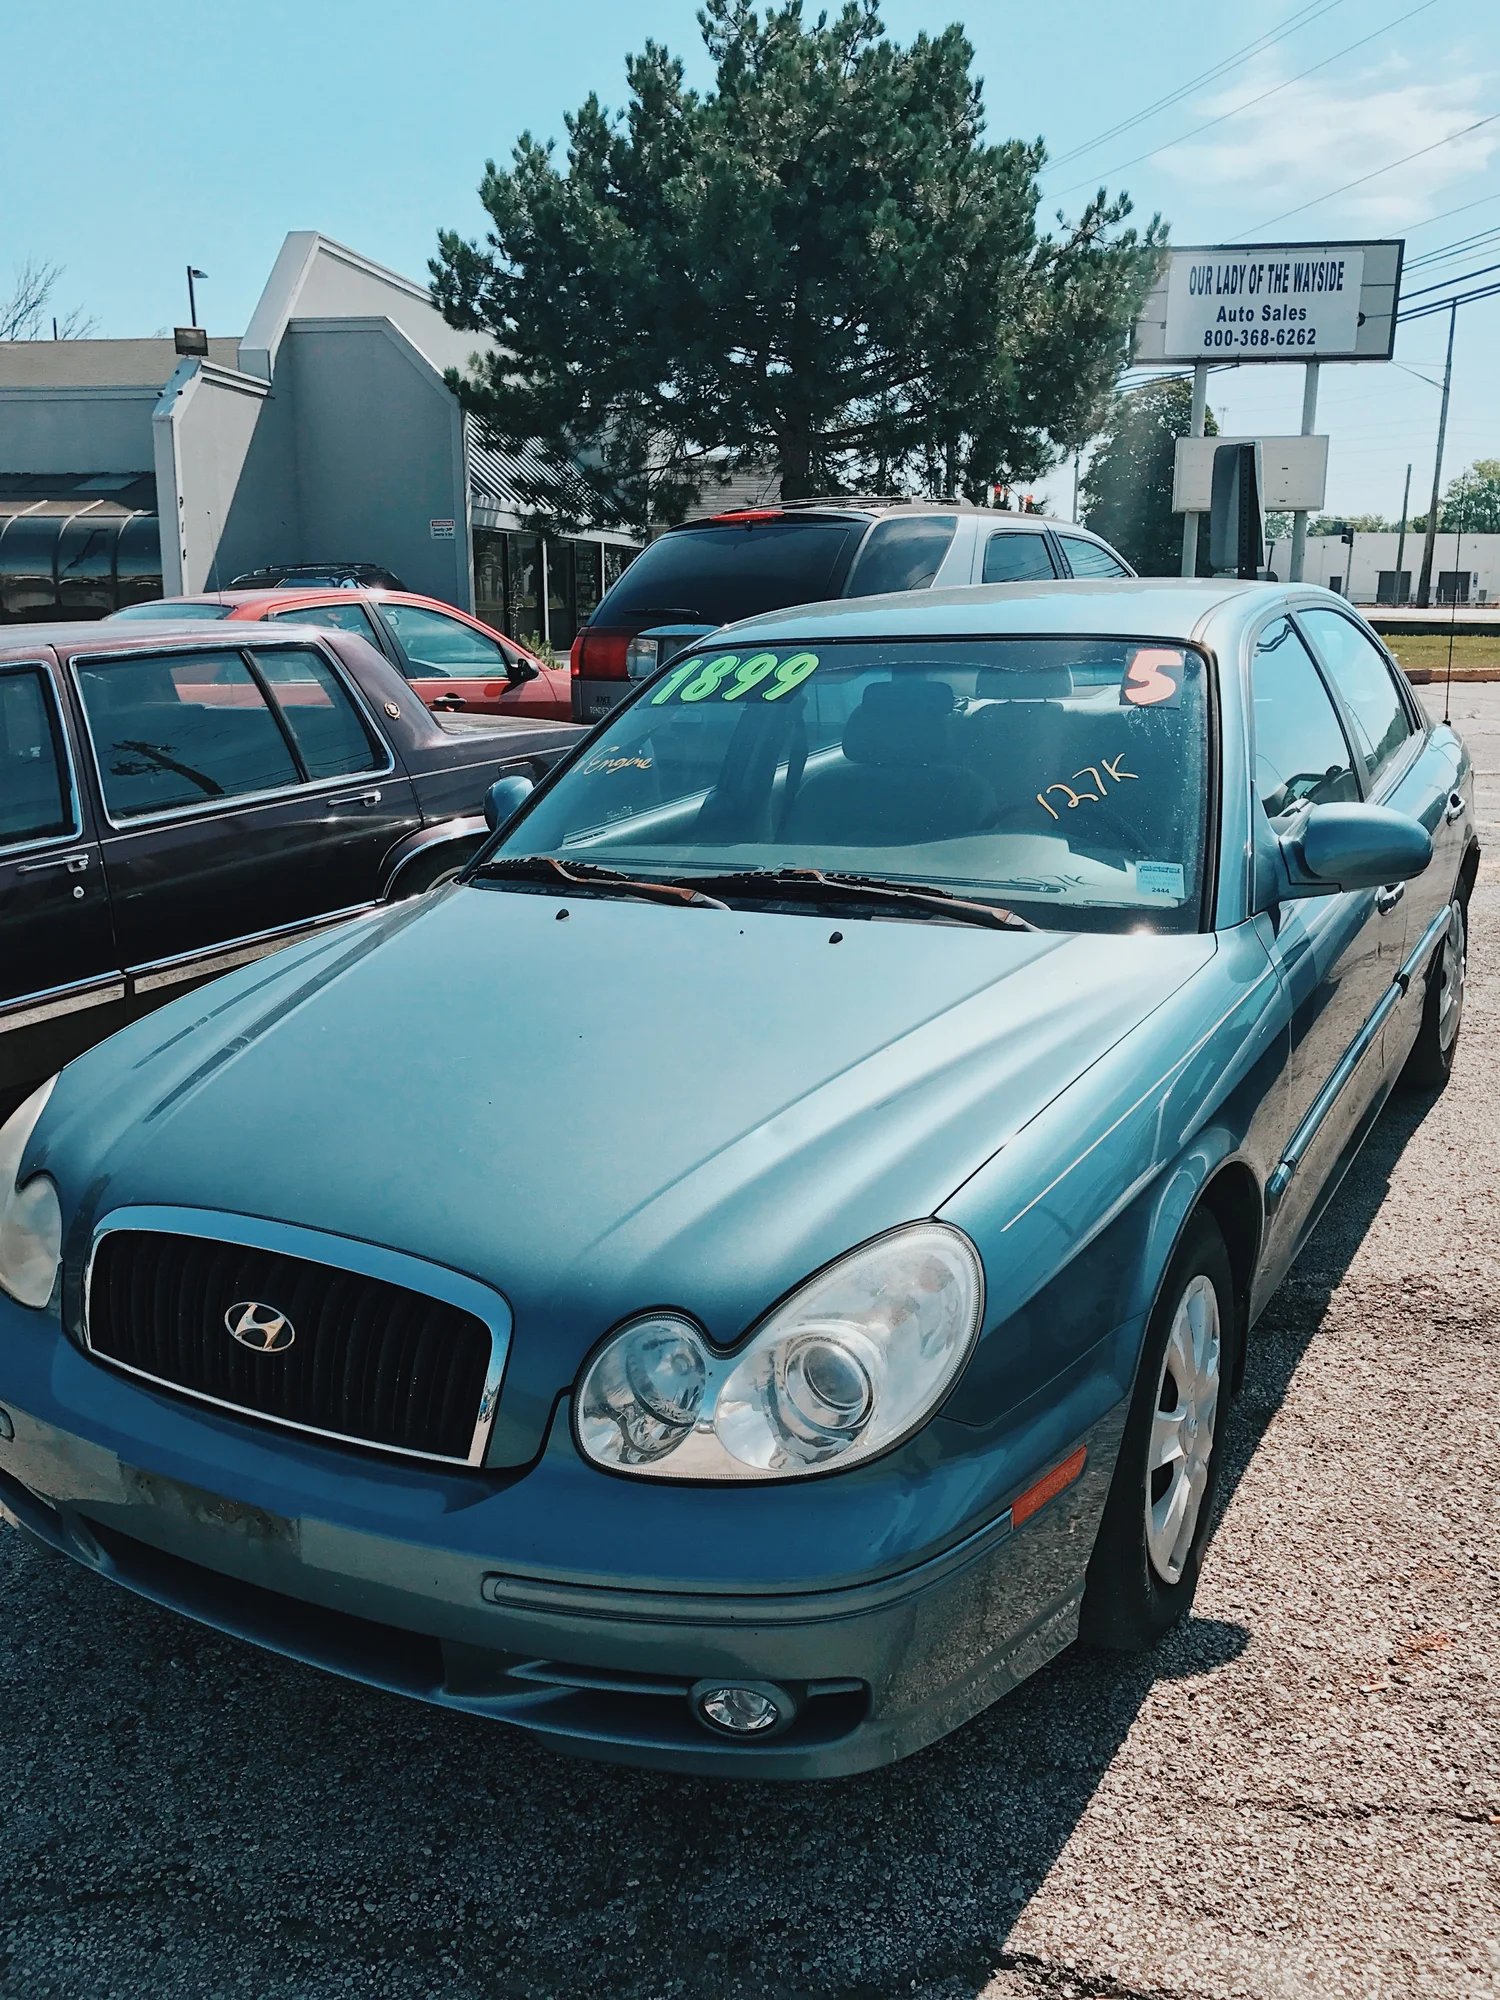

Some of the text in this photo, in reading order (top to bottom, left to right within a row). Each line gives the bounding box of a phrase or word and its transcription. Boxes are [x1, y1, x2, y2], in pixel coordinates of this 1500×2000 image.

[1189, 261, 1345, 296] OUR LADY OF THE WAYSIDE
[1216, 304, 1307, 323] Auto Sales
[1203, 328, 1317, 347] 800-368-6262
[651, 652, 820, 705] 1899
[1124, 648, 1184, 706] 5
[1036, 752, 1140, 820] 127K
